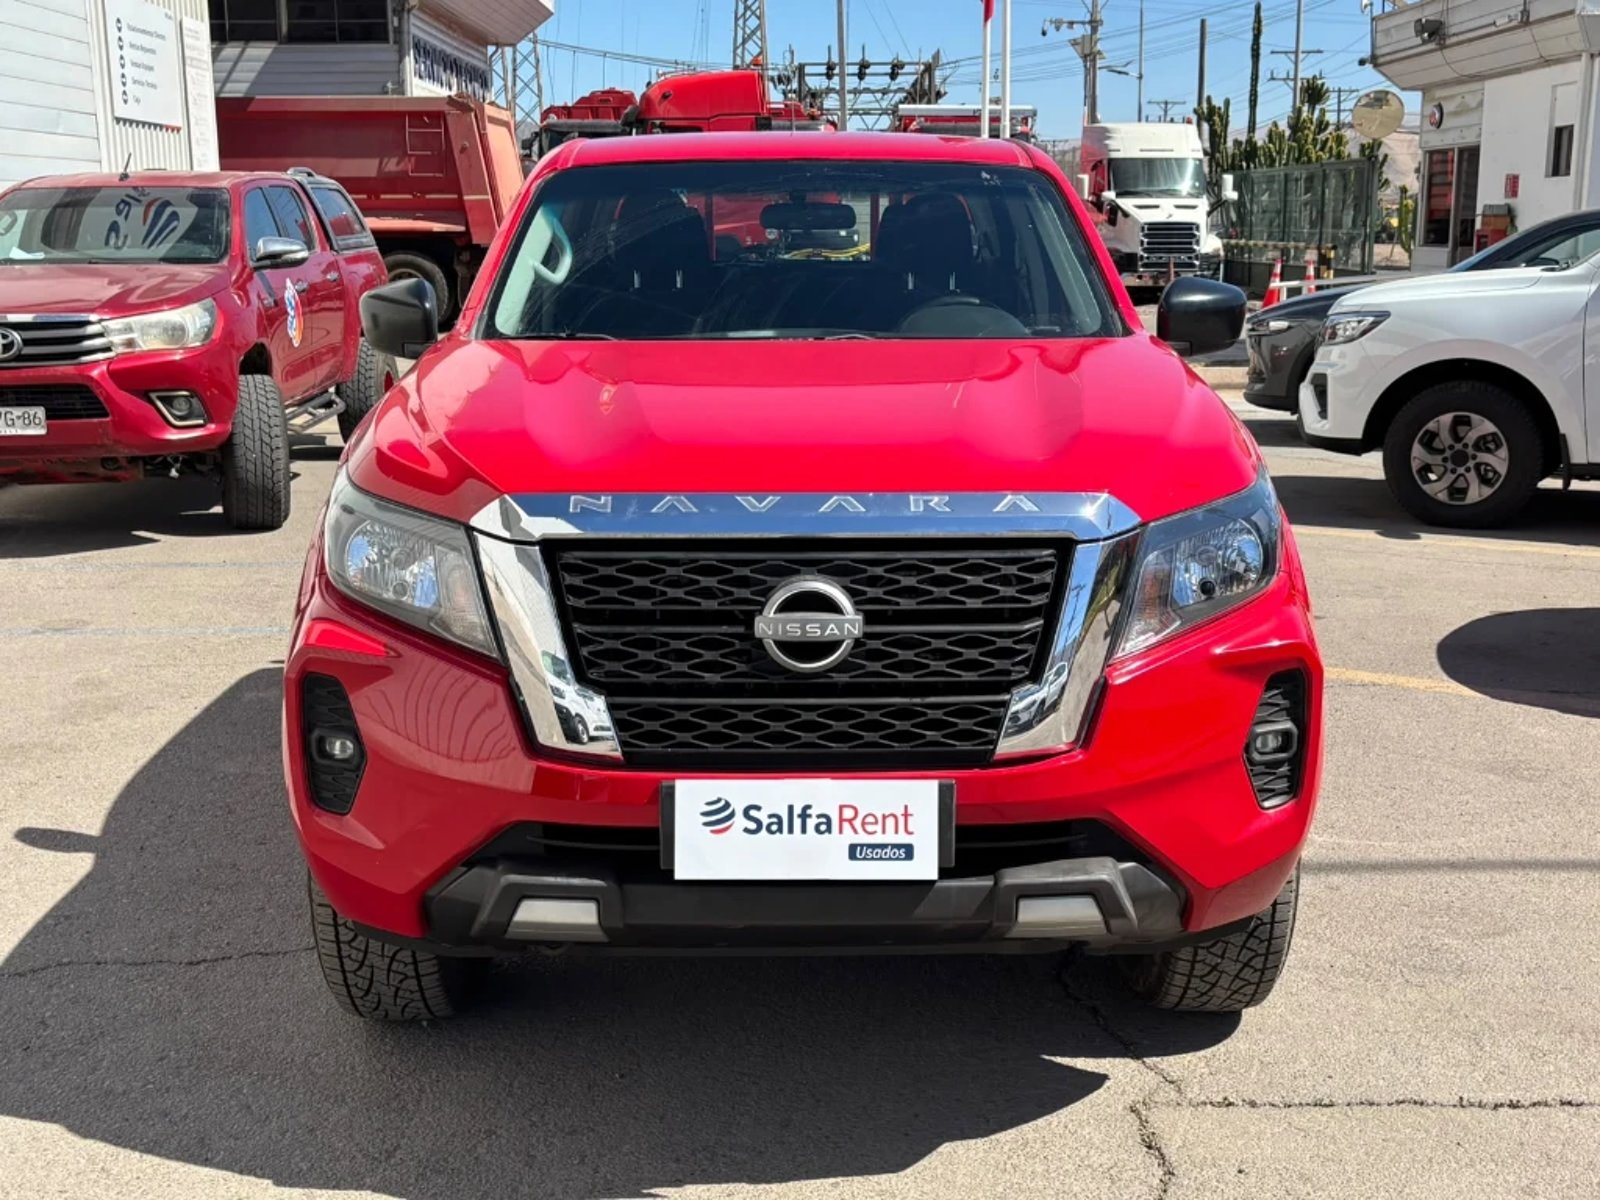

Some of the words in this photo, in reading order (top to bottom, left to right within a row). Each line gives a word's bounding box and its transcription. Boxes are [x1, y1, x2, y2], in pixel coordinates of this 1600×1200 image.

[569, 494, 1039, 513] NAVARA
[759, 622, 859, 637] NISSAN
[742, 803, 914, 835] SalfaRent
[855, 845, 906, 860] Usados
